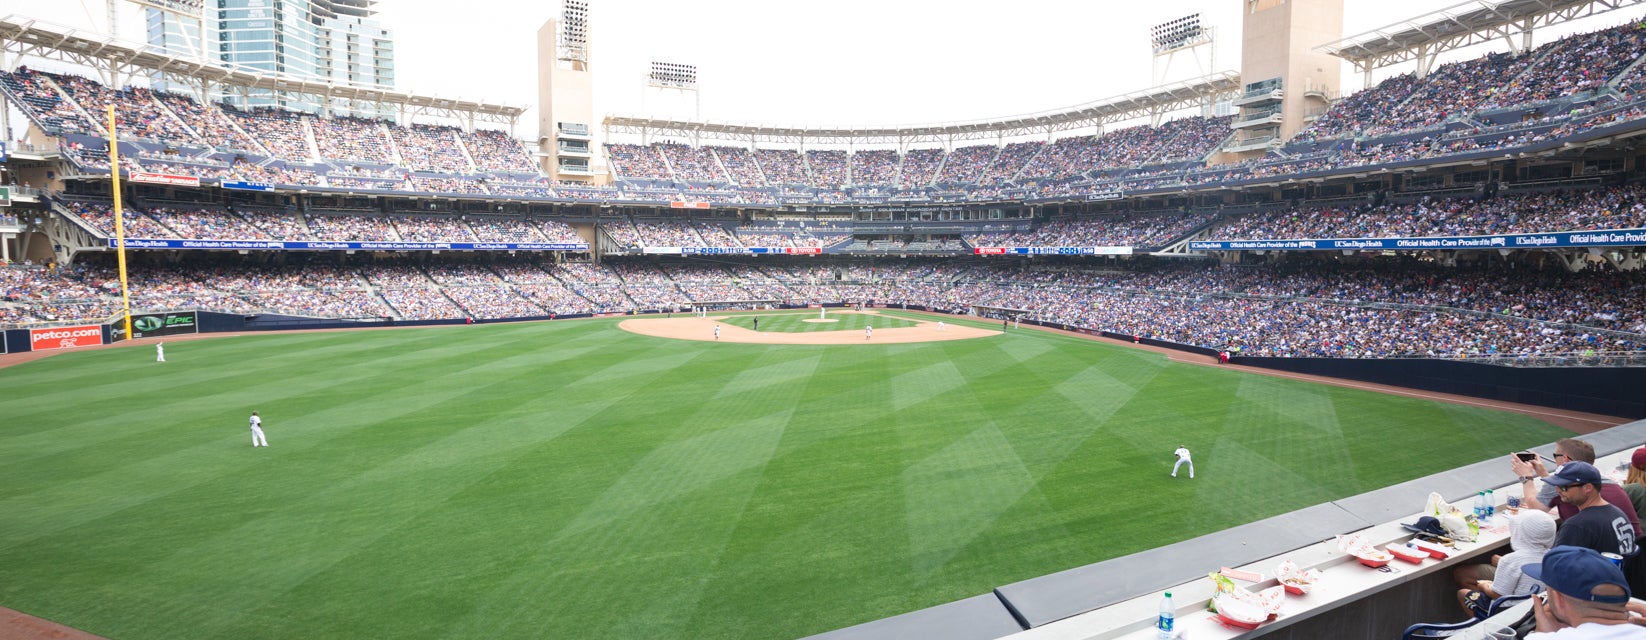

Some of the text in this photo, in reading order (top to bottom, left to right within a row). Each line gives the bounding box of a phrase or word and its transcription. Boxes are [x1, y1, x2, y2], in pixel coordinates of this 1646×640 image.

[1516, 237, 1524, 245] UC
[1530, 236, 1543, 246] Diego
[1543, 235, 1557, 244] Health
[1570, 234, 1589, 243] Official
[1589, 233, 1609, 243] Health
[1610, 233, 1625, 242] Care
[165, 316, 193, 325] EPIC
[33, 328, 100, 342] petco.com
